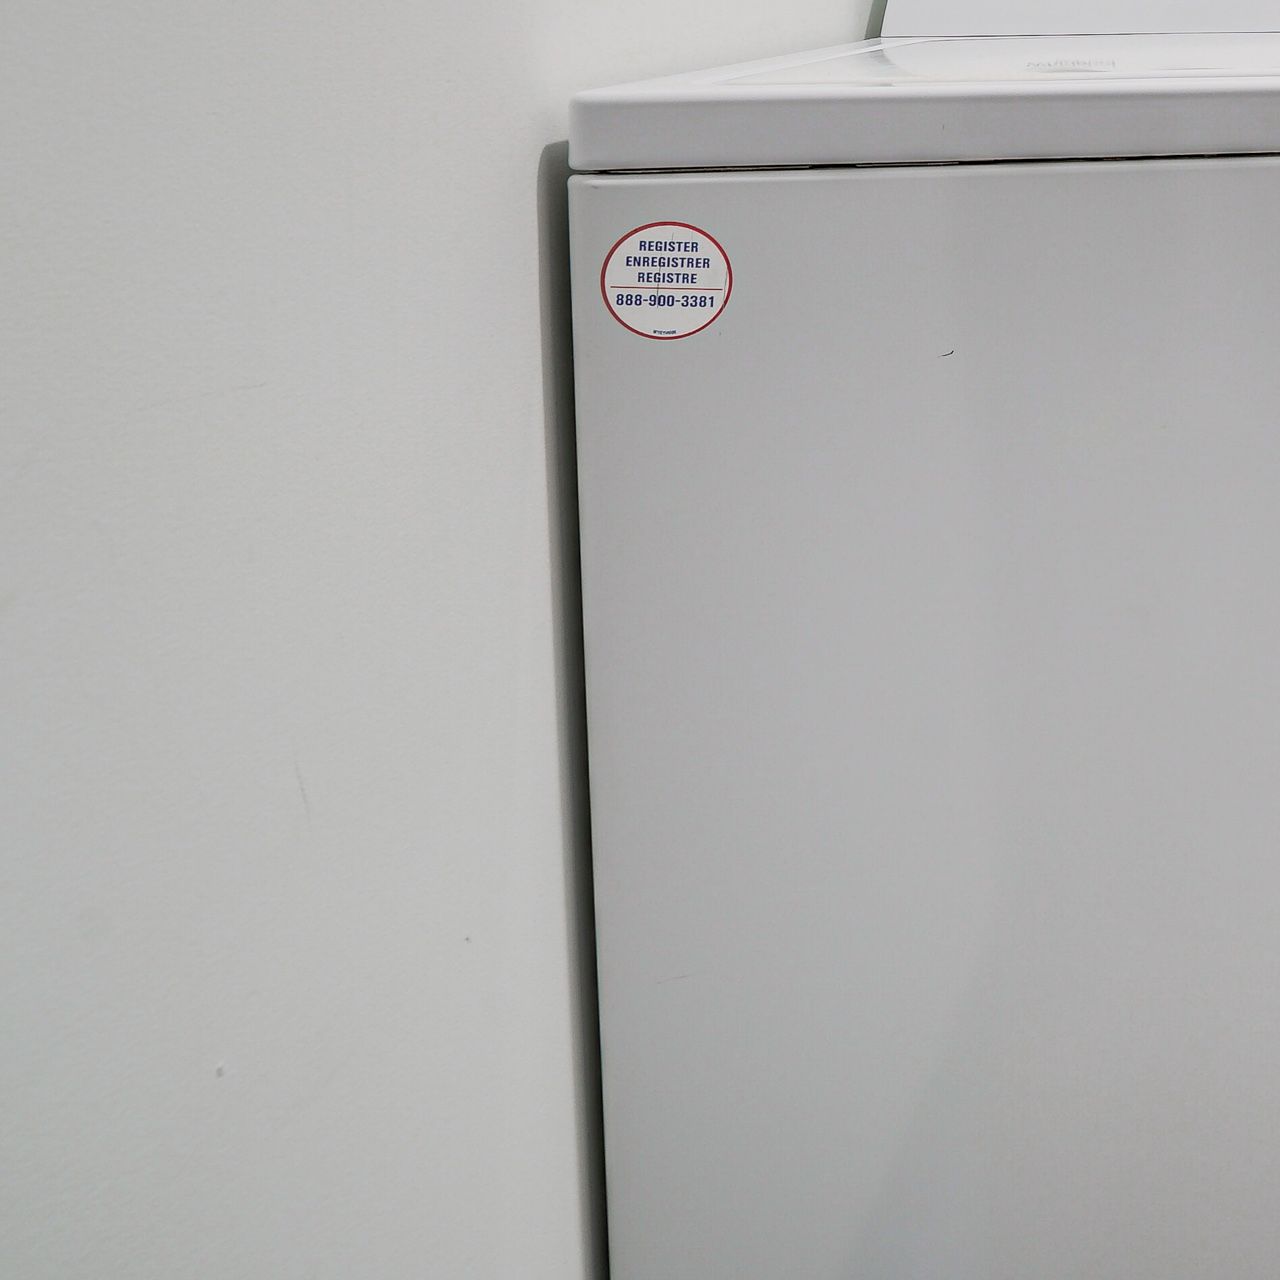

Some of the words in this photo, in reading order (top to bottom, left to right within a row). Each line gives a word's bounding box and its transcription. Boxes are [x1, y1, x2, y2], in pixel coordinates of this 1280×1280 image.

[639, 241, 699, 252] REGISTER
[626, 256, 710, 268] ENREGISTRER
[637, 272, 697, 284] REGISTRE
[616, 294, 714, 308] 888-900-3381
